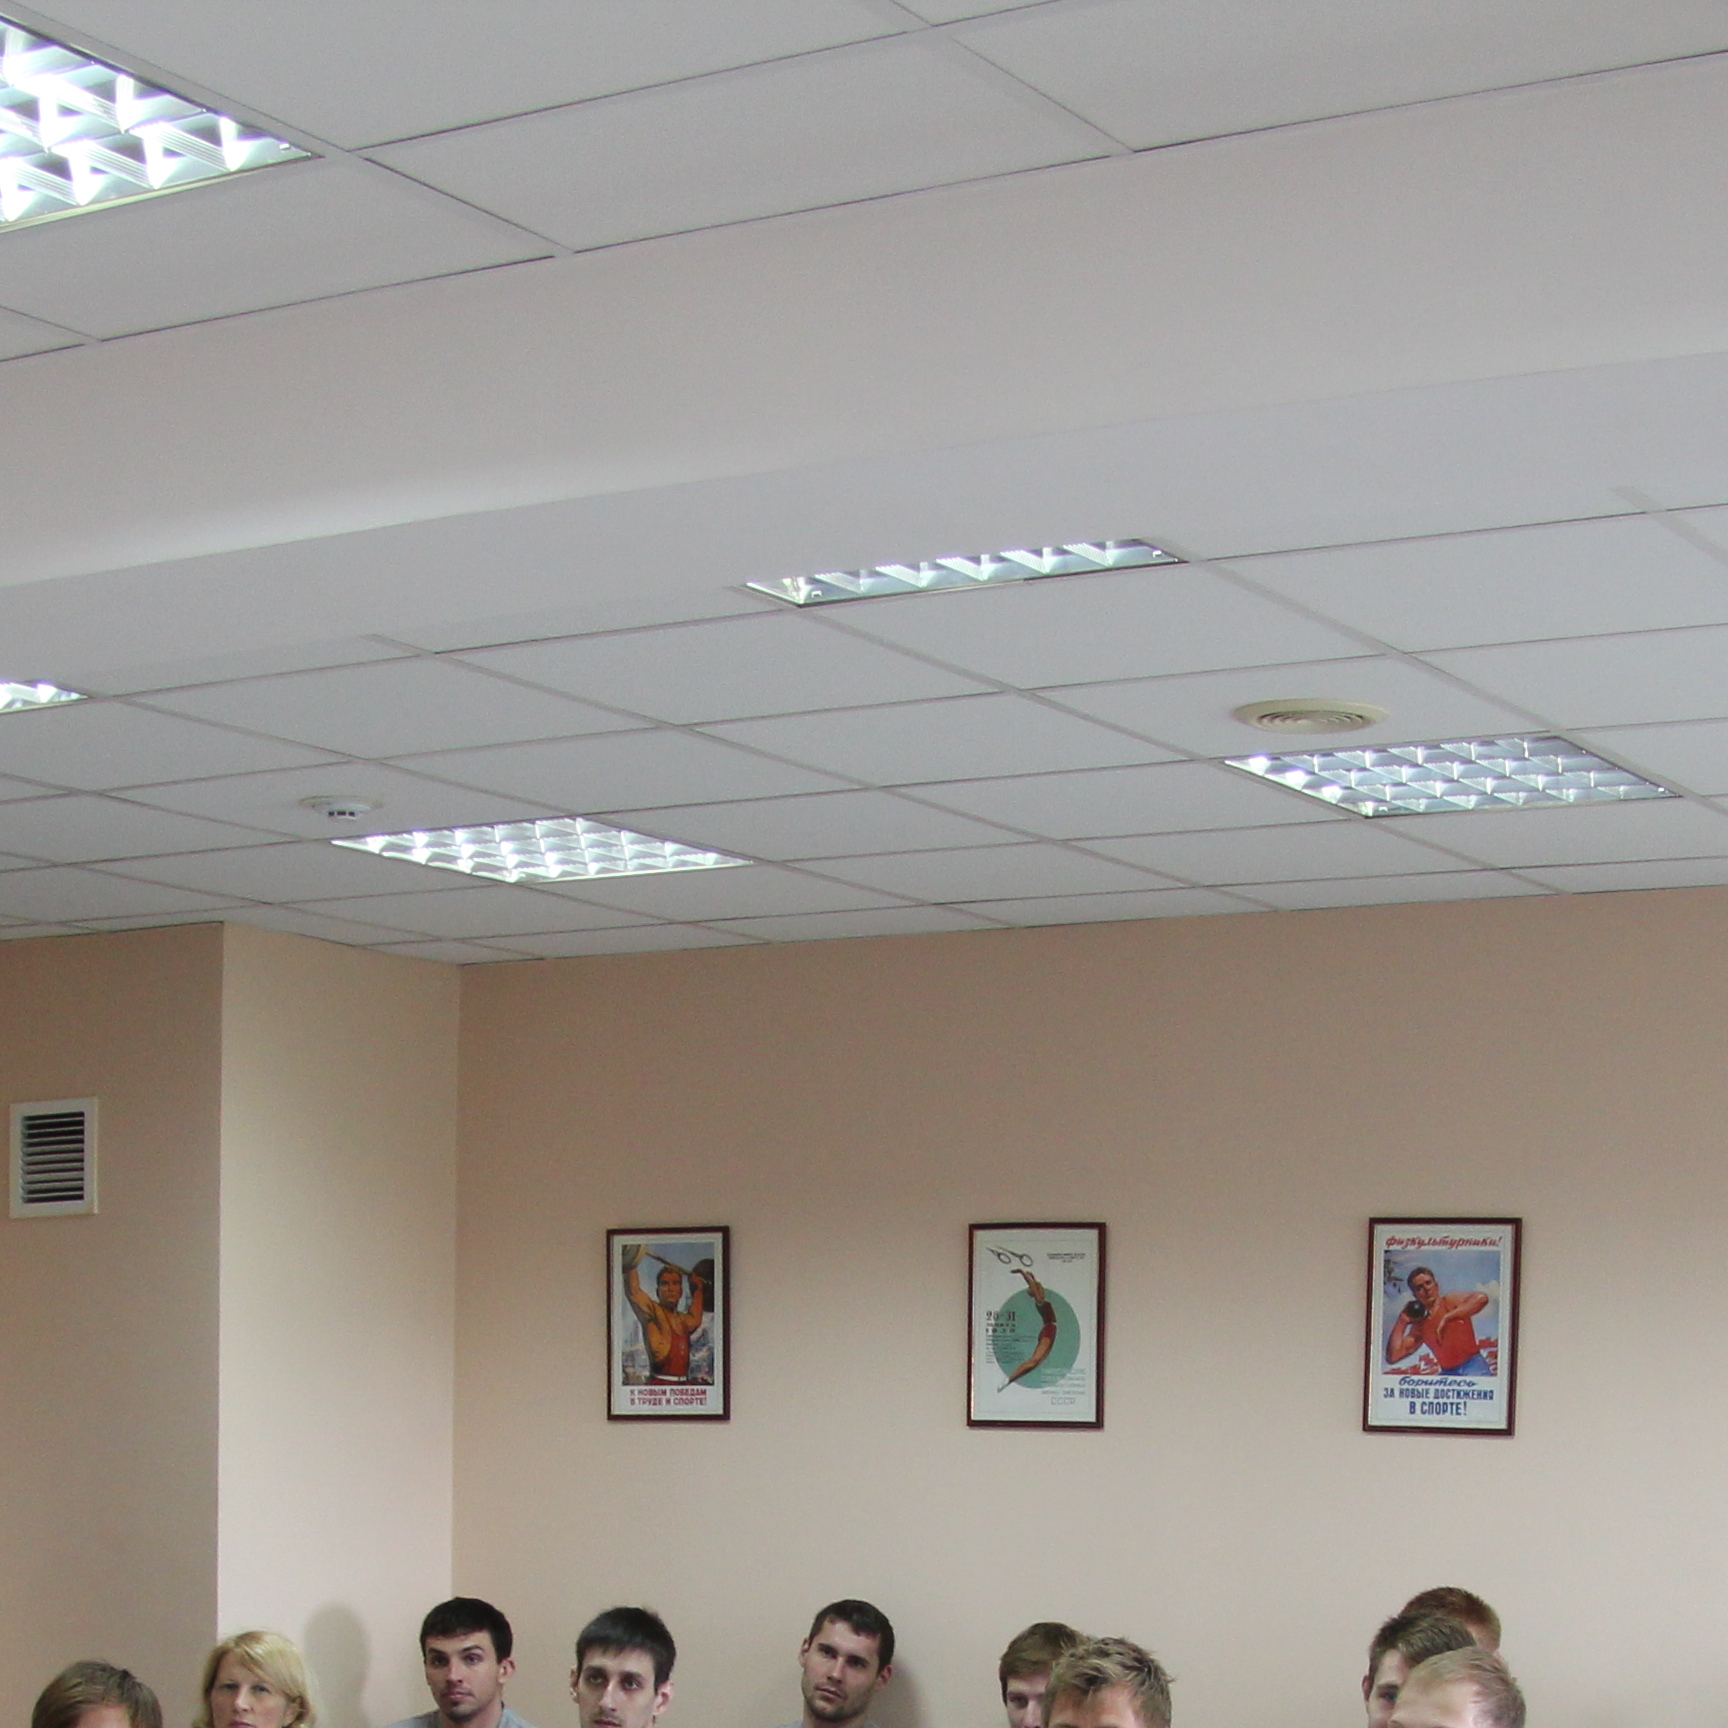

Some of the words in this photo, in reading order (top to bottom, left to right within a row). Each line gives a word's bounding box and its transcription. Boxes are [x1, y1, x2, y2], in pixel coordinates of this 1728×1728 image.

[1384, 1387, 1395, 1398] ЗА
[1399, 1388, 1430, 1399] НОВЫЕ
[1433, 1388, 1494, 1400] ДОСТИЖЕНИЯ
[1409, 1401, 1416, 1415] В
[1420, 1401, 1467, 1416] СПОРТЕ!
